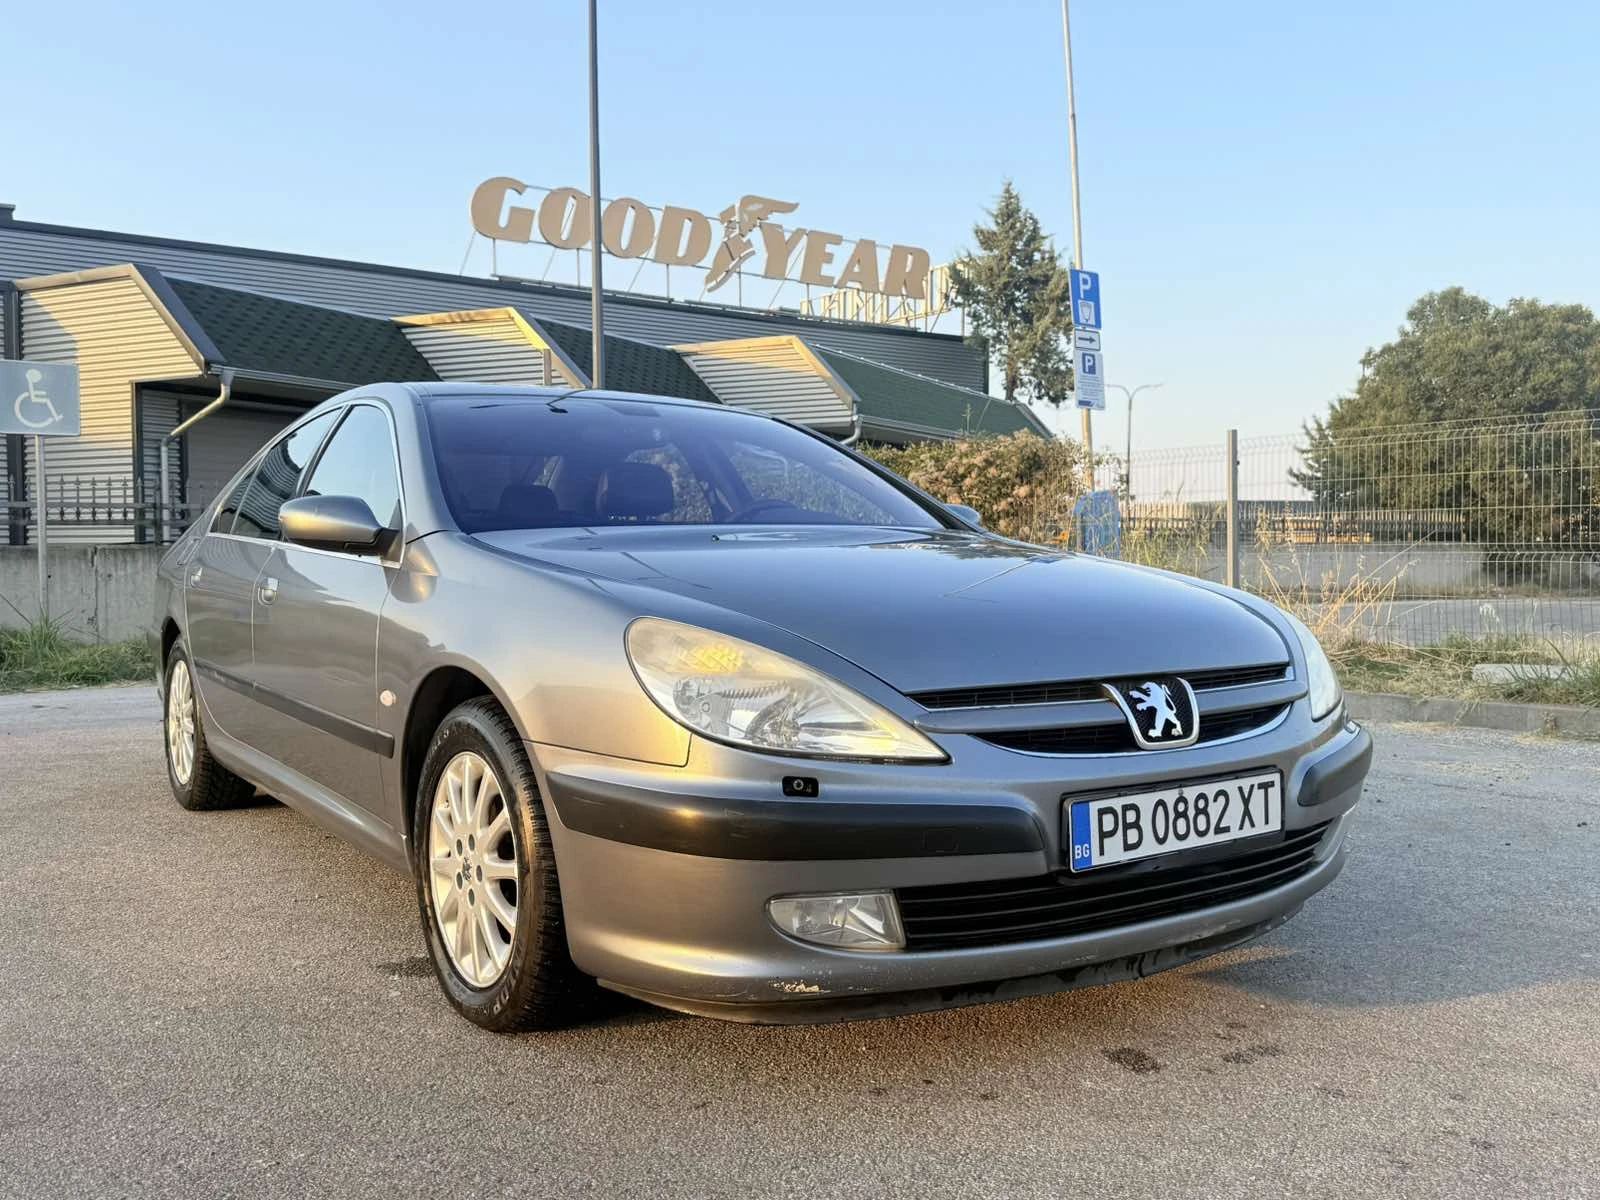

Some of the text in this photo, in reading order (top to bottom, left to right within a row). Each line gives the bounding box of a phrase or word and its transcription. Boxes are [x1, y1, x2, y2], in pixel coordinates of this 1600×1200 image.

[1078, 272, 1092, 299] P
[1084, 355, 1094, 373] P
[1097, 780, 1275, 857] PB 0882 XT
[1074, 844, 1090, 859] BG
